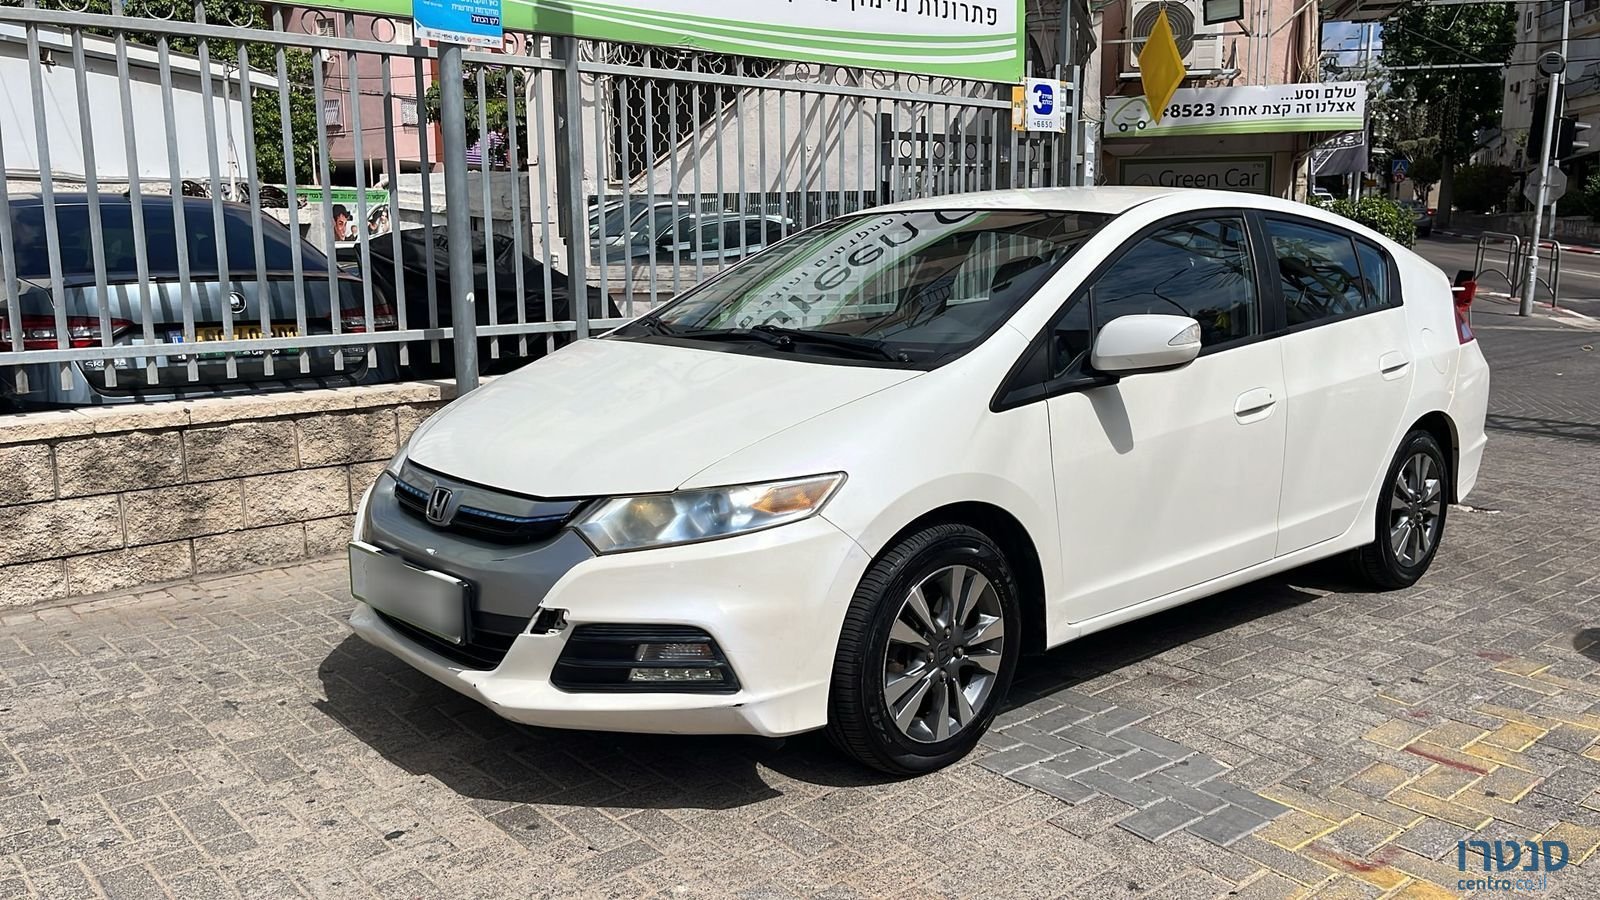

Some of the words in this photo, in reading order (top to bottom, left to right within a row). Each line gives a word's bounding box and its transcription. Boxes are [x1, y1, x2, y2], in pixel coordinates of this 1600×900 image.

[917, 0, 998, 26] פתרונות
[1281, 89, 1322, 101] וסע...
[1324, 86, 1357, 99] שלם
[1219, 105, 1257, 116] אחרת
[1262, 104, 1291, 117] קצת
[1296, 102, 1311, 113] זה
[1316, 100, 1356, 113] אצלנו
[1158, 169, 1219, 187] Green
[1224, 167, 1260, 186] Car
